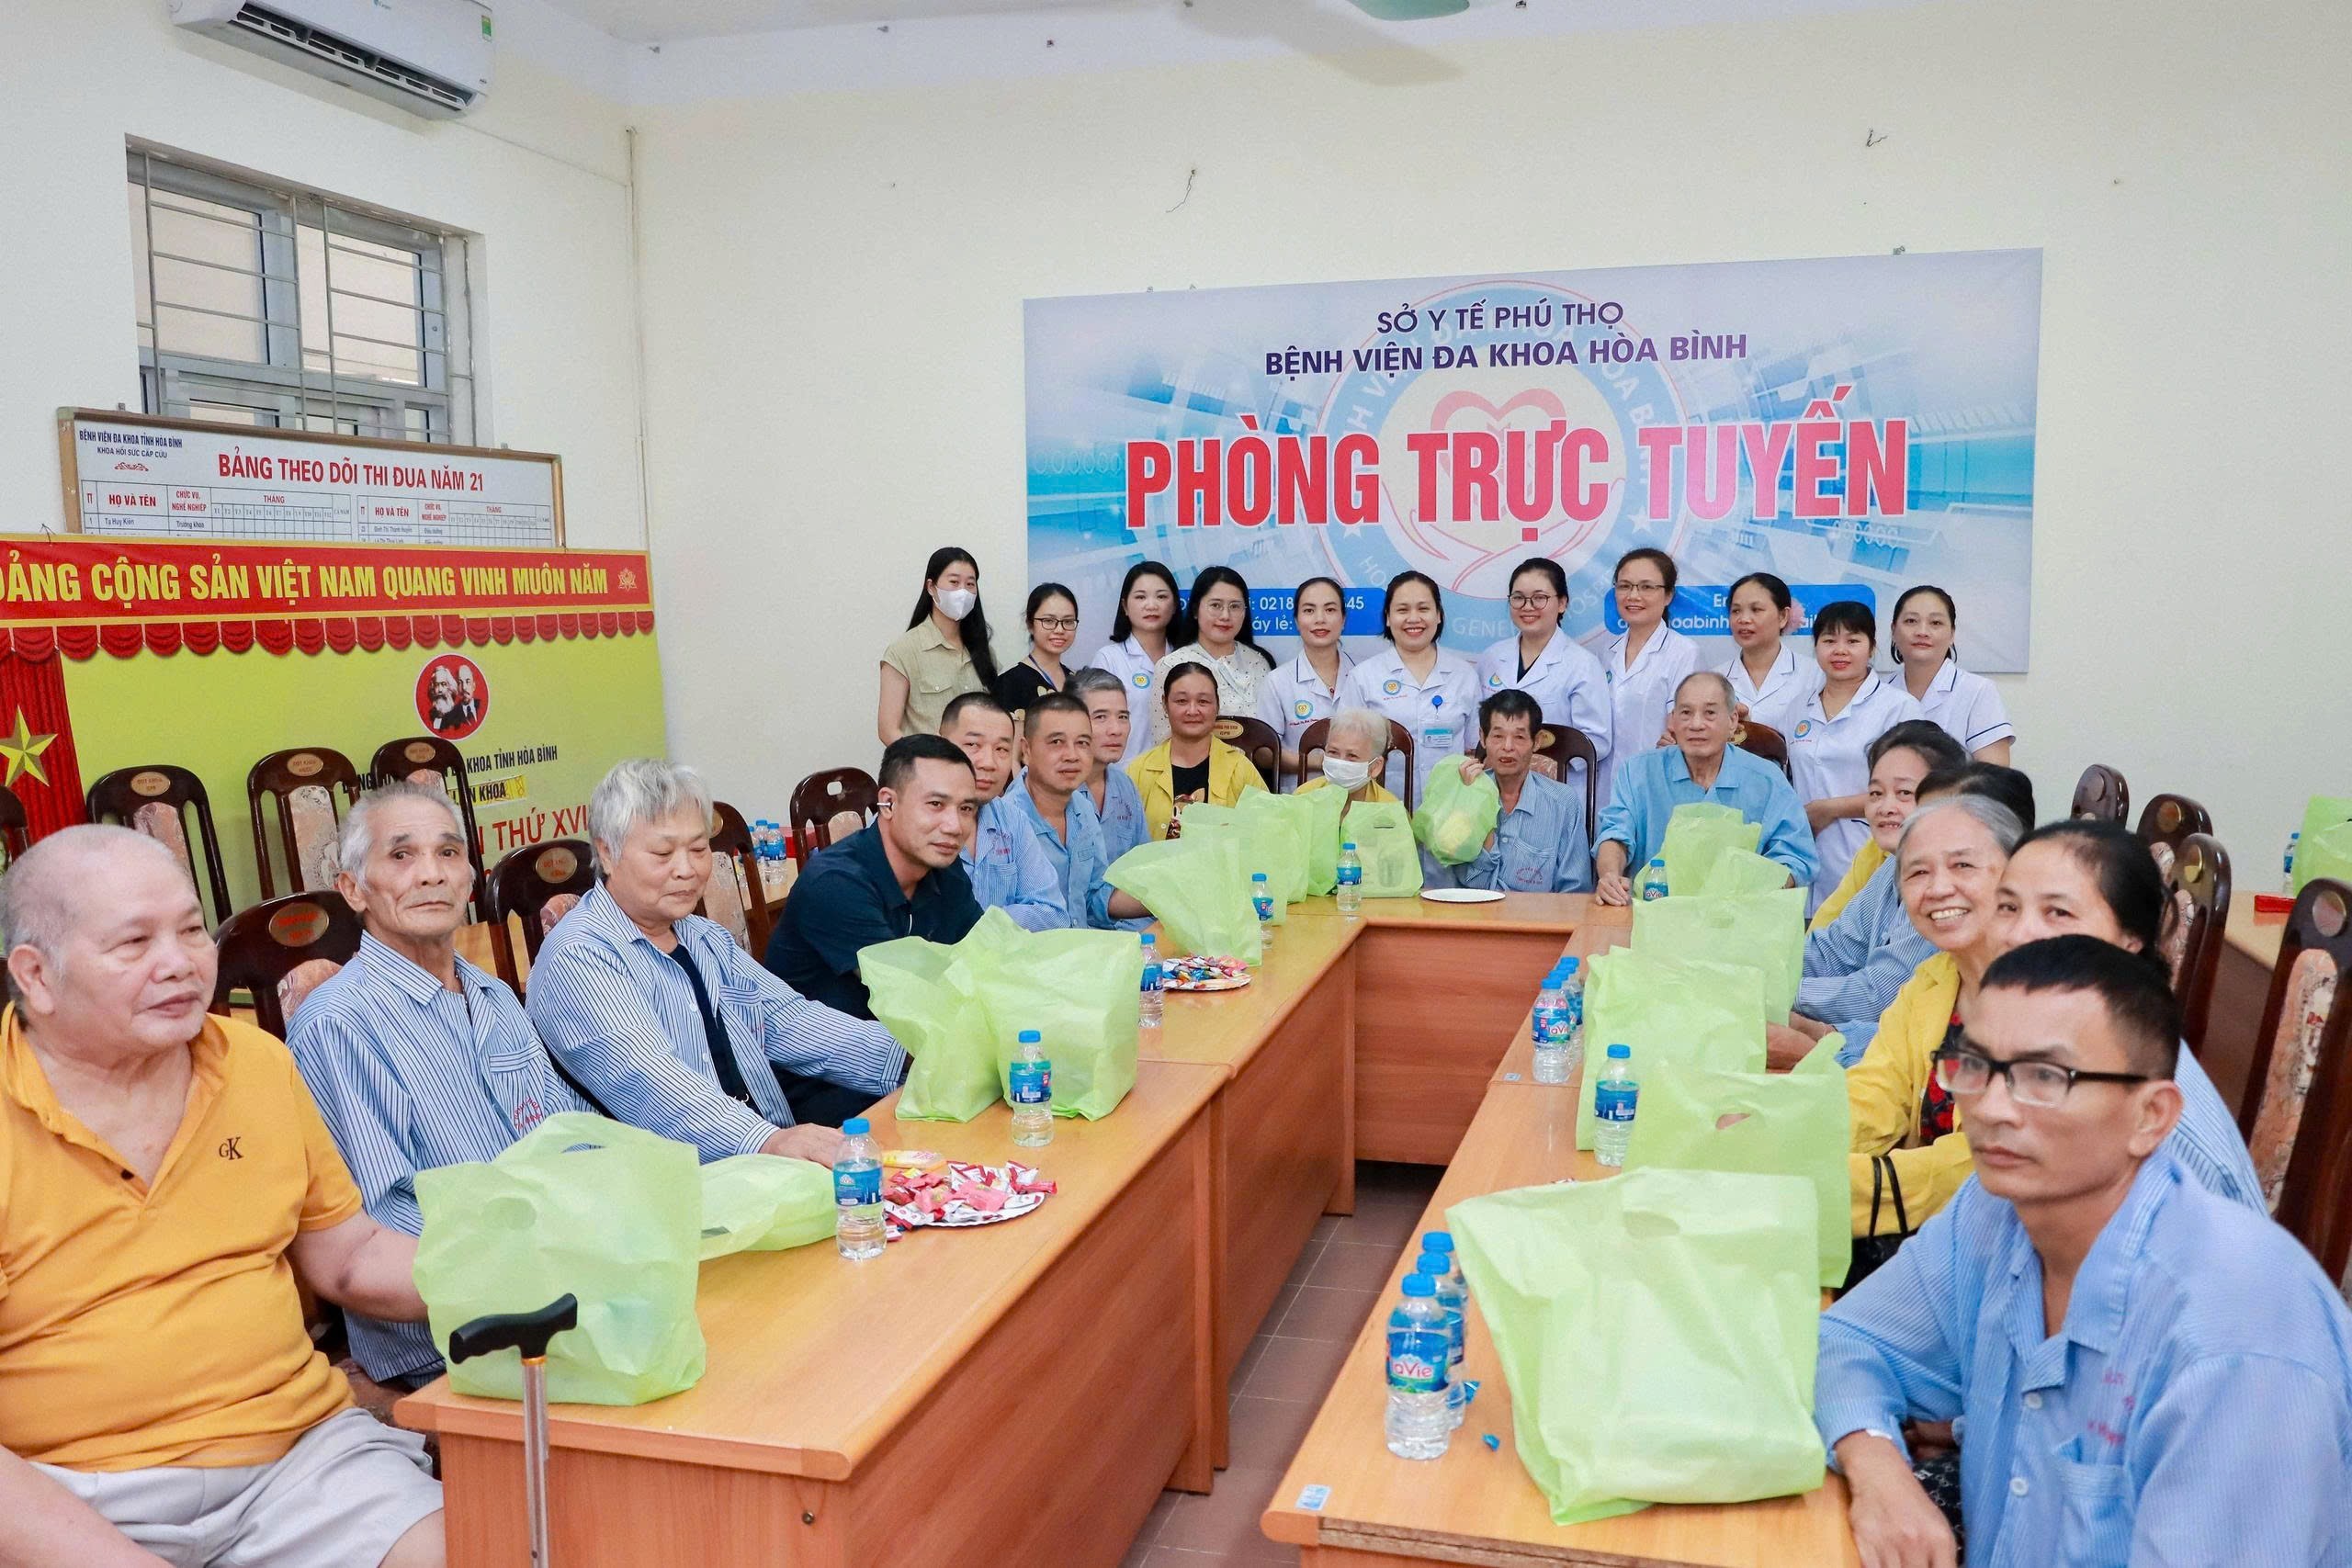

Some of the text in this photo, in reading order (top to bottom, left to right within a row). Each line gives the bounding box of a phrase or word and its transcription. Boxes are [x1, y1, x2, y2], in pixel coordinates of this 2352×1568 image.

[1377, 303, 1418, 333] SỞ
[1428, 310, 1446, 331] Y
[1455, 299, 1487, 329] TẾ
[1495, 298, 1552, 329] PHÚ
[1562, 302, 1623, 328] THỌ
[1266, 329, 1747, 381] BỆNH VIỆN ĐA KHOA HÒA BÌNH
[79, 429, 96, 445] BỆNH
[97, 431, 112, 445] VIỆN
[113, 434, 121, 443] ĐA
[123, 434, 139, 445] KHOA
[219, 446, 483, 491] BẢNG THEO DÕI THI ĐUA NĂM 21
[1127, 385, 1906, 542] PHÒNG TRỰC TUYẾN
[108, 493, 156, 507] HỌ VÀ TÊN
[91, 556, 181, 609] CỘNG
[189, 553, 250, 600] SẢN
[255, 558, 311, 606] VIỆT
[319, 566, 376, 597] NAM
[382, 567, 456, 600] QUANG
[459, 567, 507, 596] VINH
[512, 562, 566, 595] MUÔN
[570, 563, 608, 594] NĂM
[1344, 596, 1364, 610] 45
[1252, 615, 1271, 633] áy
[467, 755, 492, 773] KHOA
[493, 747, 515, 769] TỈNH
[517, 746, 535, 766] HÒA
[479, 782, 506, 802] KHOA
[492, 807, 545, 852] THỨ
[1394, 1360, 1432, 1378] aVie
